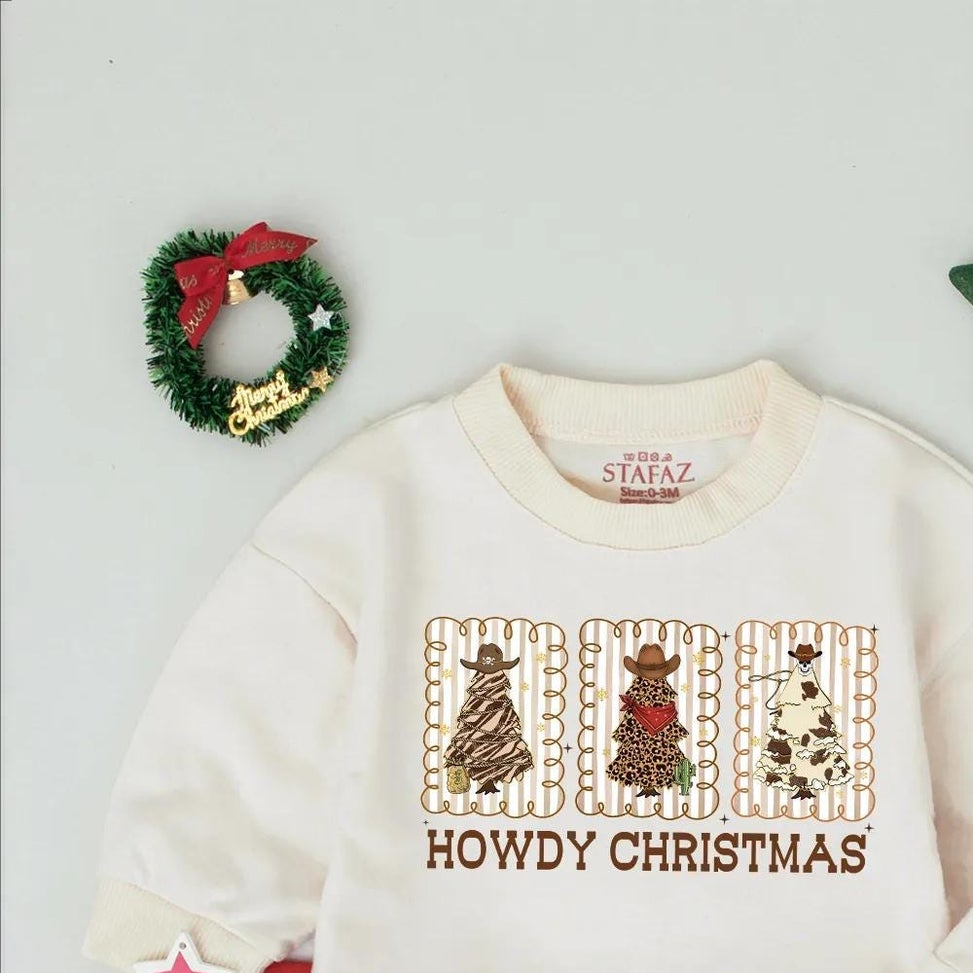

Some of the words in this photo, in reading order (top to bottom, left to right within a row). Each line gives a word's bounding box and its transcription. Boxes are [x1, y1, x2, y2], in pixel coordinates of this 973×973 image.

[231, 369, 290, 412] Merry
[602, 462, 695, 485] STAFAZ
[426, 829, 597, 871] HOWDY
[609, 831, 867, 874] CHRISTMAS
